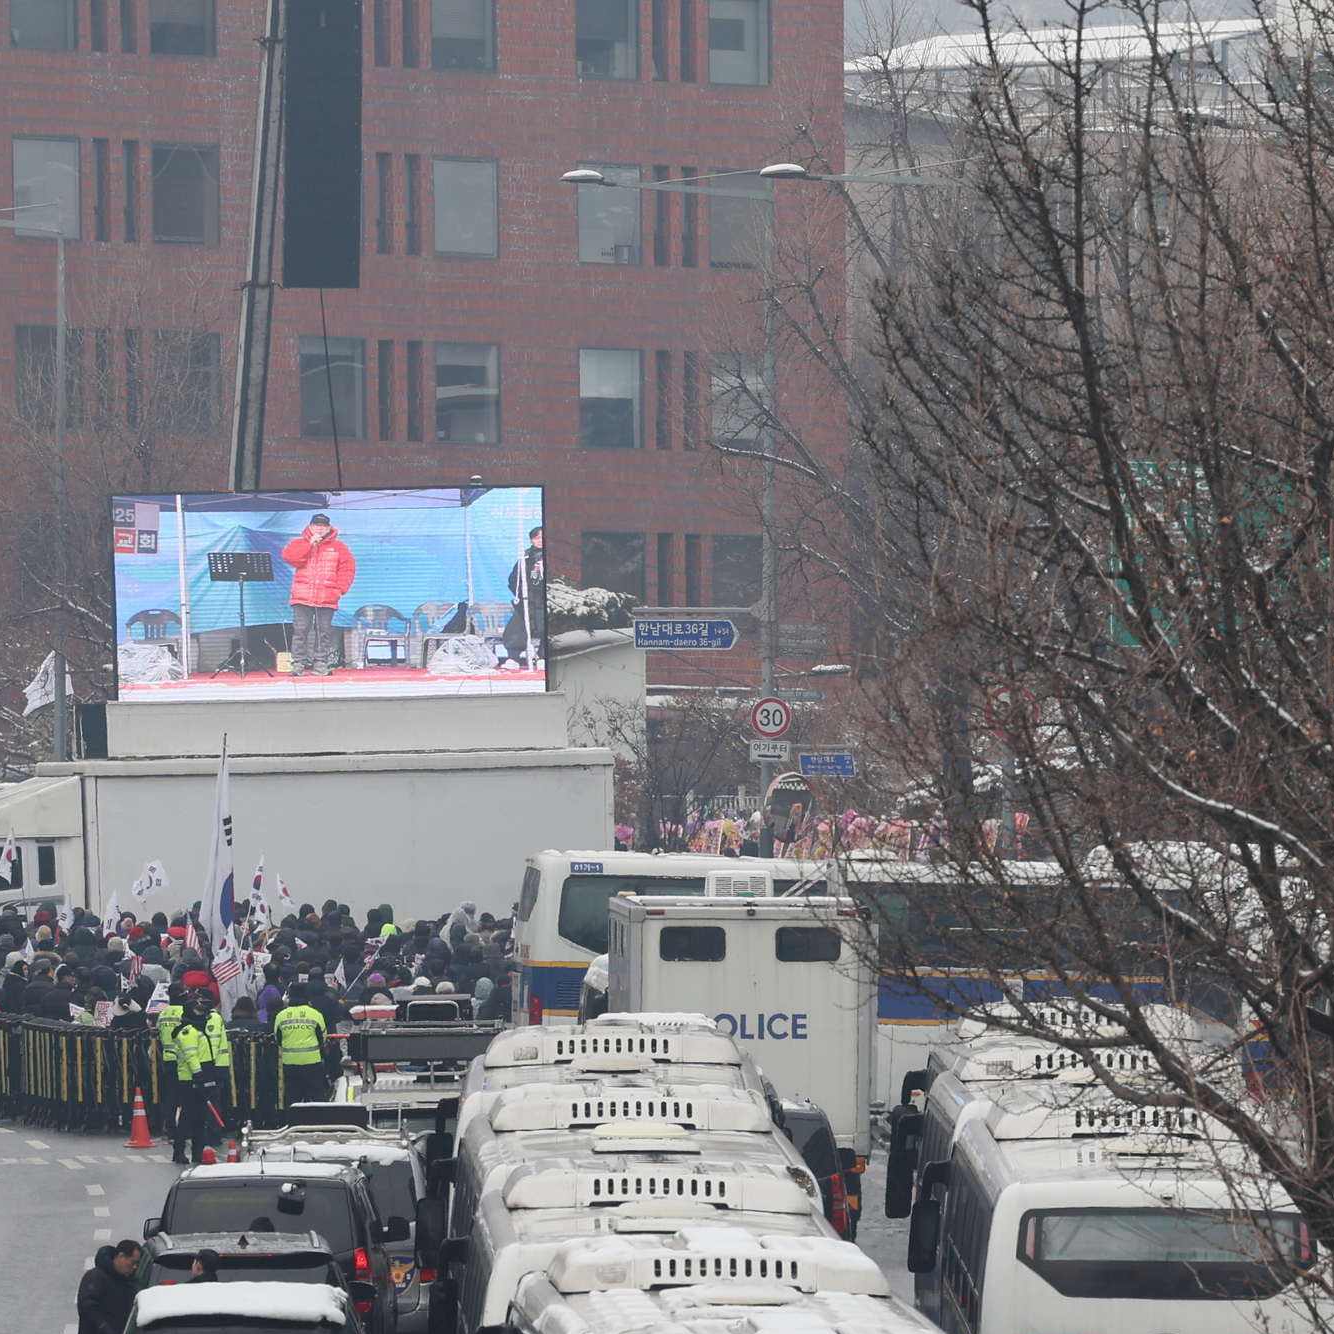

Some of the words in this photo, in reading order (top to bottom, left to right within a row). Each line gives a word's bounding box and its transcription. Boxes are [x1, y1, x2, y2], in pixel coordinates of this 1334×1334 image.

[112, 508, 135, 523] 25
[637, 622, 709, 636] 한남대로36길
[637, 638, 697, 646] Hannam-daero
[699, 638, 722, 647] 36-gil
[759, 708, 784, 727] 30
[753, 743, 787, 753] 여기부터
[712, 1012, 808, 1040] OLICE
